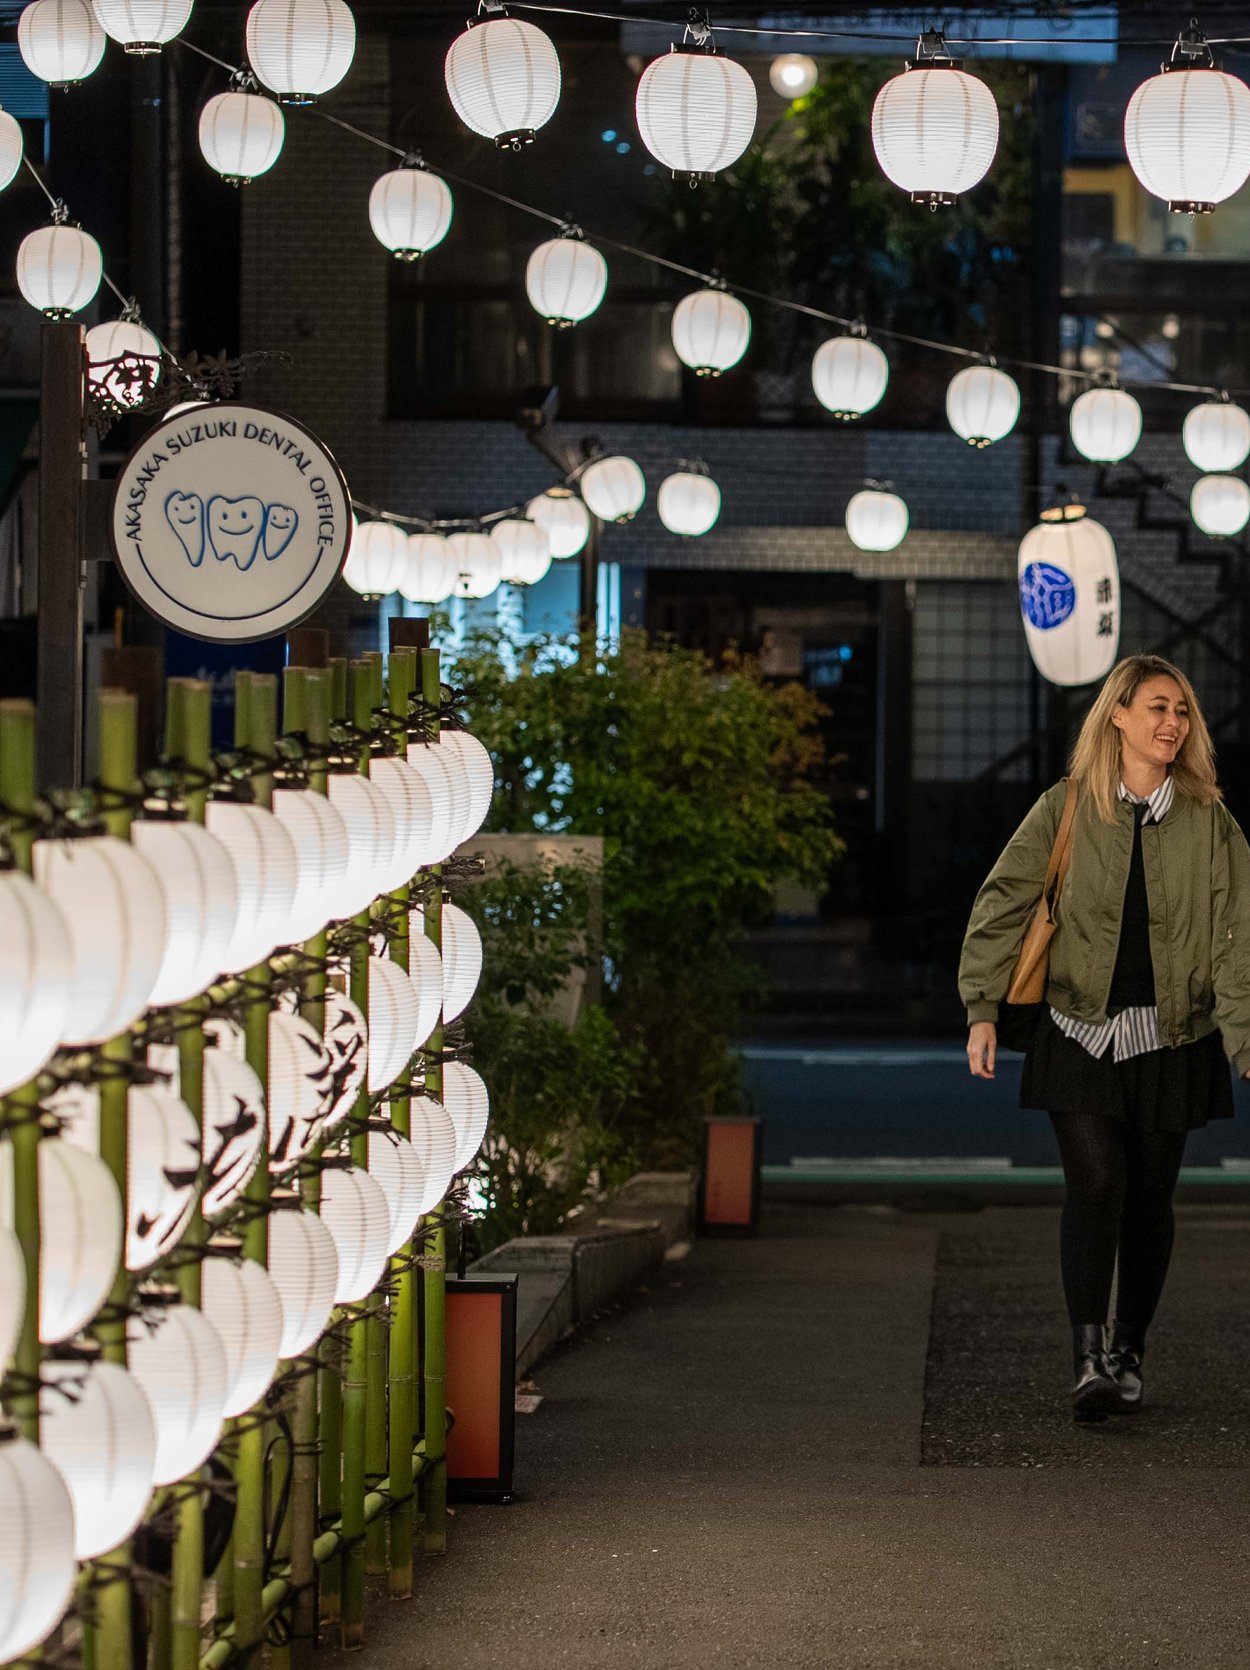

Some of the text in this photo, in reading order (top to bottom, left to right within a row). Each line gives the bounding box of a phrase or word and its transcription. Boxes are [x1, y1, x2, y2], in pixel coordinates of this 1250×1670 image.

[125, 421, 335, 547] AKASAKA SUZUKI DENTAL OFFICE
